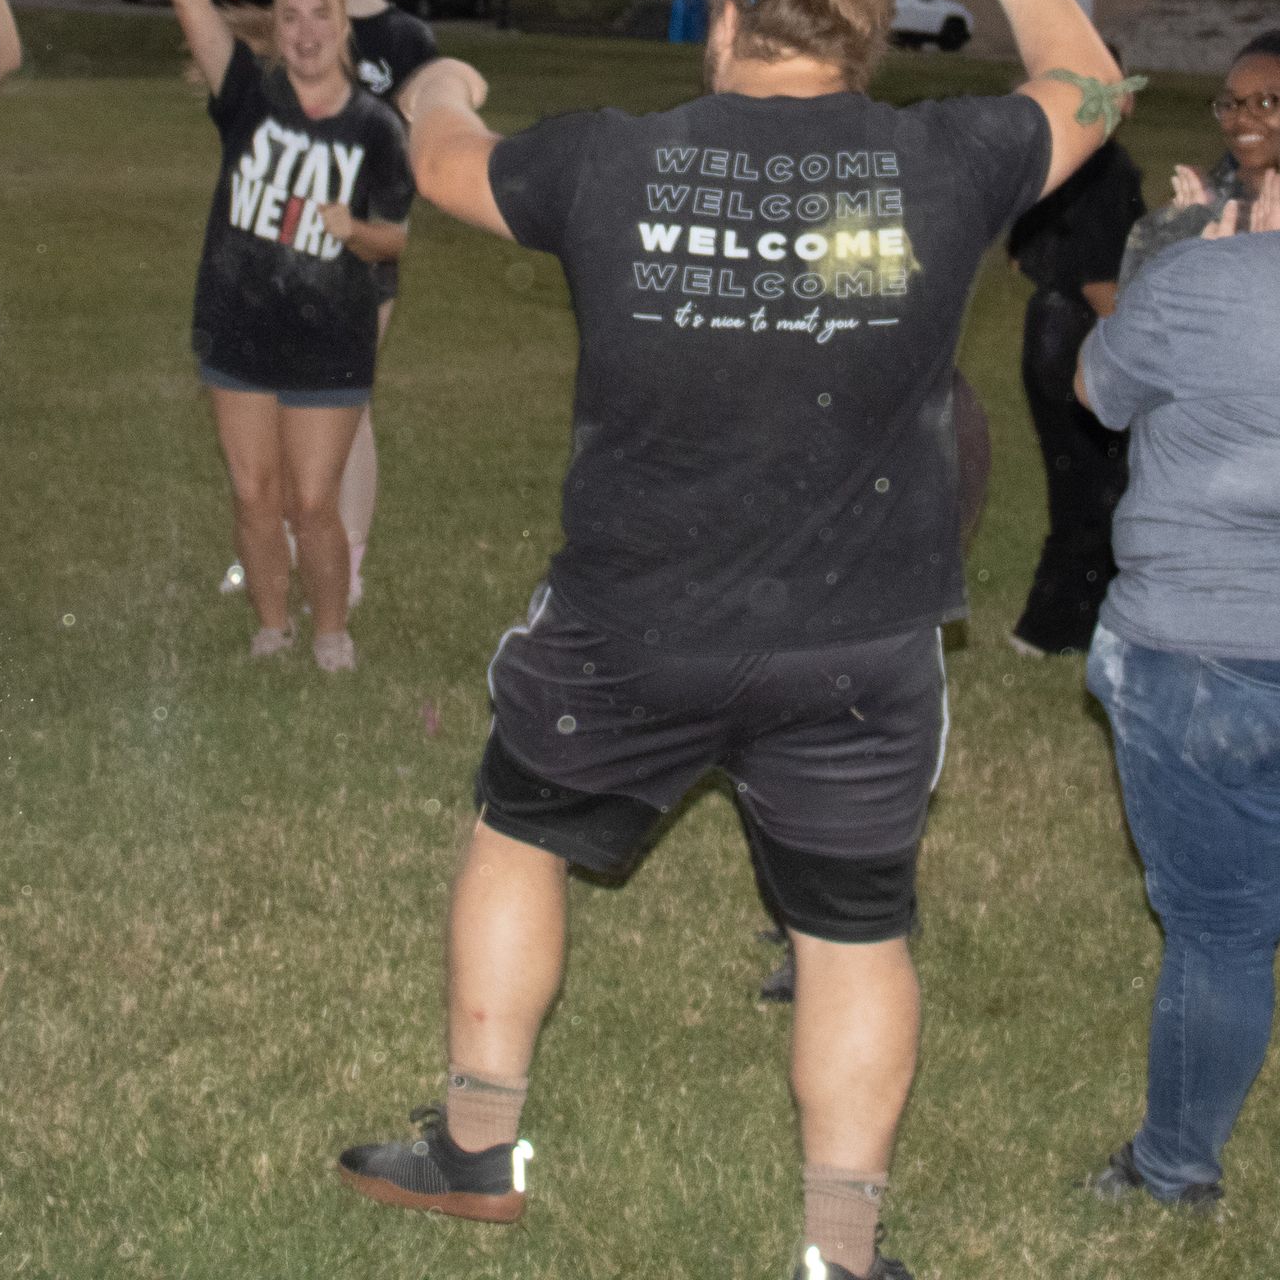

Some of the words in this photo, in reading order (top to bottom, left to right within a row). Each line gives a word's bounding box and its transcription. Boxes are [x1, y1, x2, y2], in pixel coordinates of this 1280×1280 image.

[238, 116, 365, 206] STAY
[656, 147, 899, 183] WELCOME
[646, 184, 903, 221] WELCOME
[637, 222, 906, 261] WELCOME
[632, 262, 908, 299] WELCOME
[673, 301, 704, 328] it's
[710, 313, 746, 329] nice
[749, 306, 767, 332] to
[776, 305, 820, 332] meet
[816, 316, 859, 345] you
